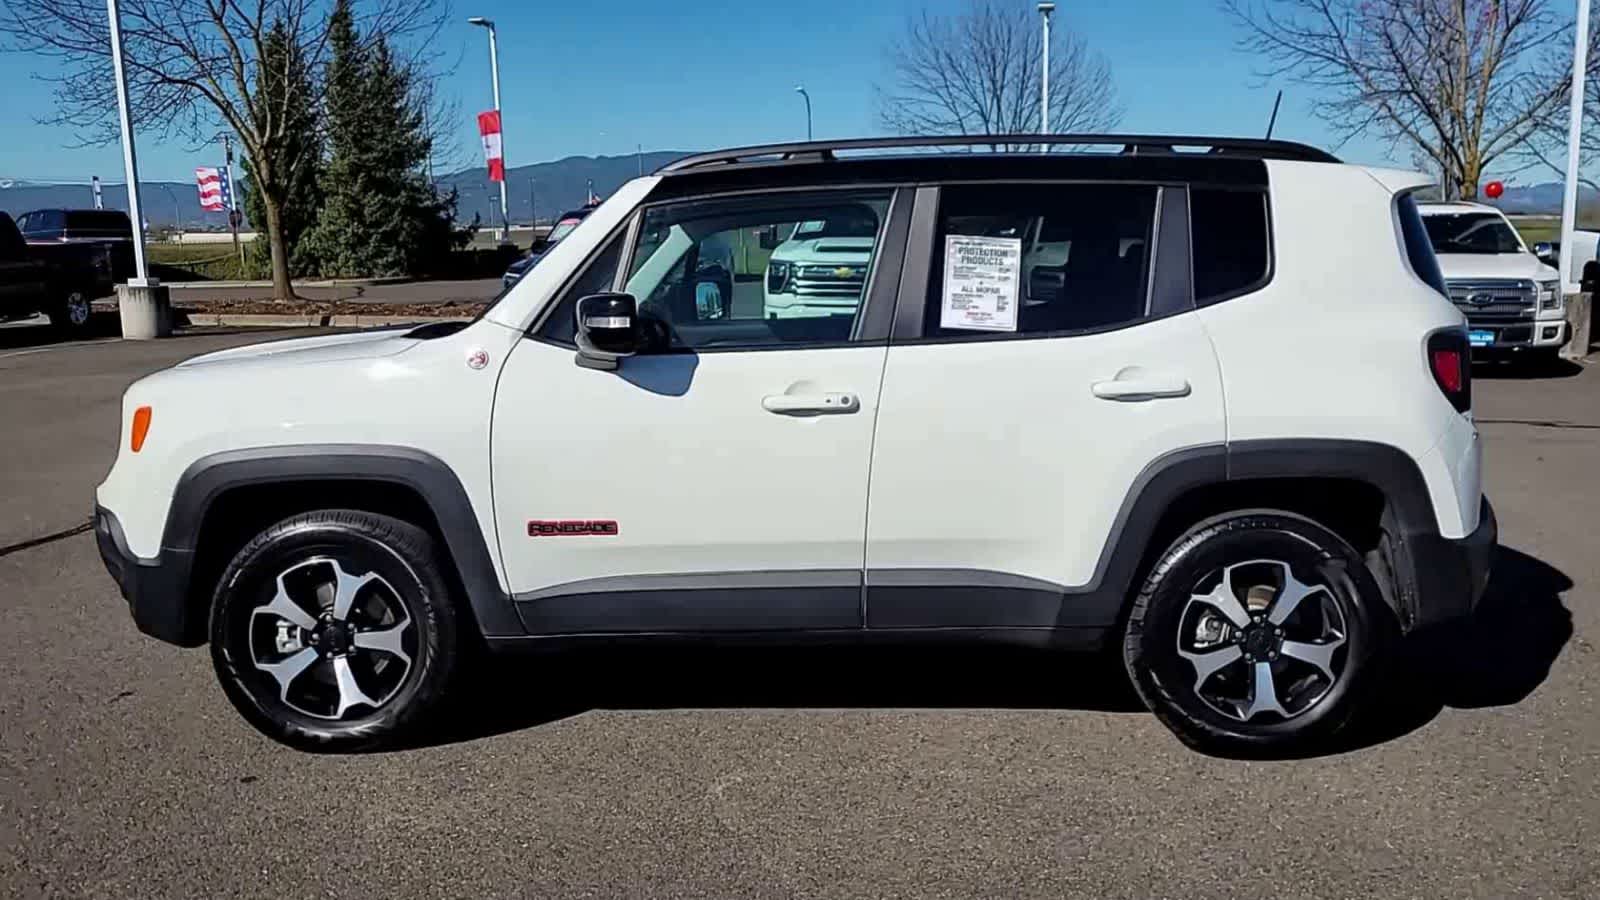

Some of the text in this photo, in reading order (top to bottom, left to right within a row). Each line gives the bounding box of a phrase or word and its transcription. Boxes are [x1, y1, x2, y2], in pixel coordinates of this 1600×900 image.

[958, 247, 1008, 257] PROTECTION
[961, 256, 1004, 266] PRODUCTS
[961, 285, 1001, 294] ALL MOPAR
[528, 520, 618, 536] RENEGADE
